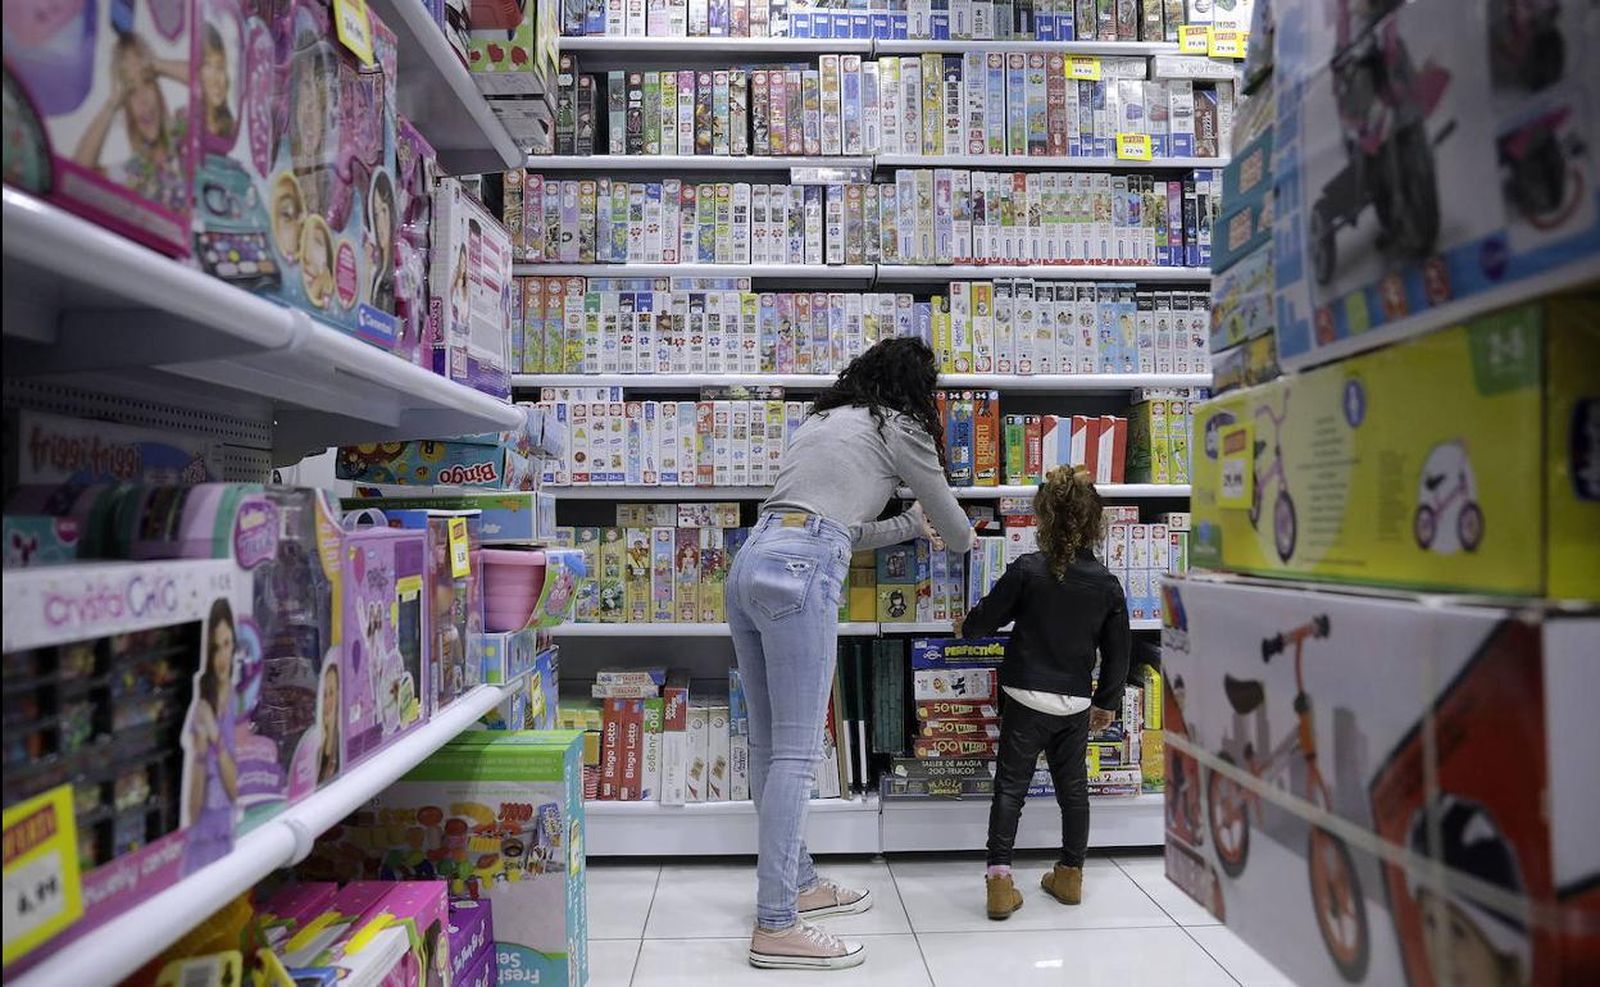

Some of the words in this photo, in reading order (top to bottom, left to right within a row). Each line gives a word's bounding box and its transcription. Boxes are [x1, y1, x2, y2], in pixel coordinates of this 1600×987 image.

[440, 462, 496, 483] Bingo
[607, 721, 616, 748] Lotto
[626, 722, 637, 749] Lotto
[605, 749, 616, 778] Bingo
[625, 750, 636, 779] Bingo
